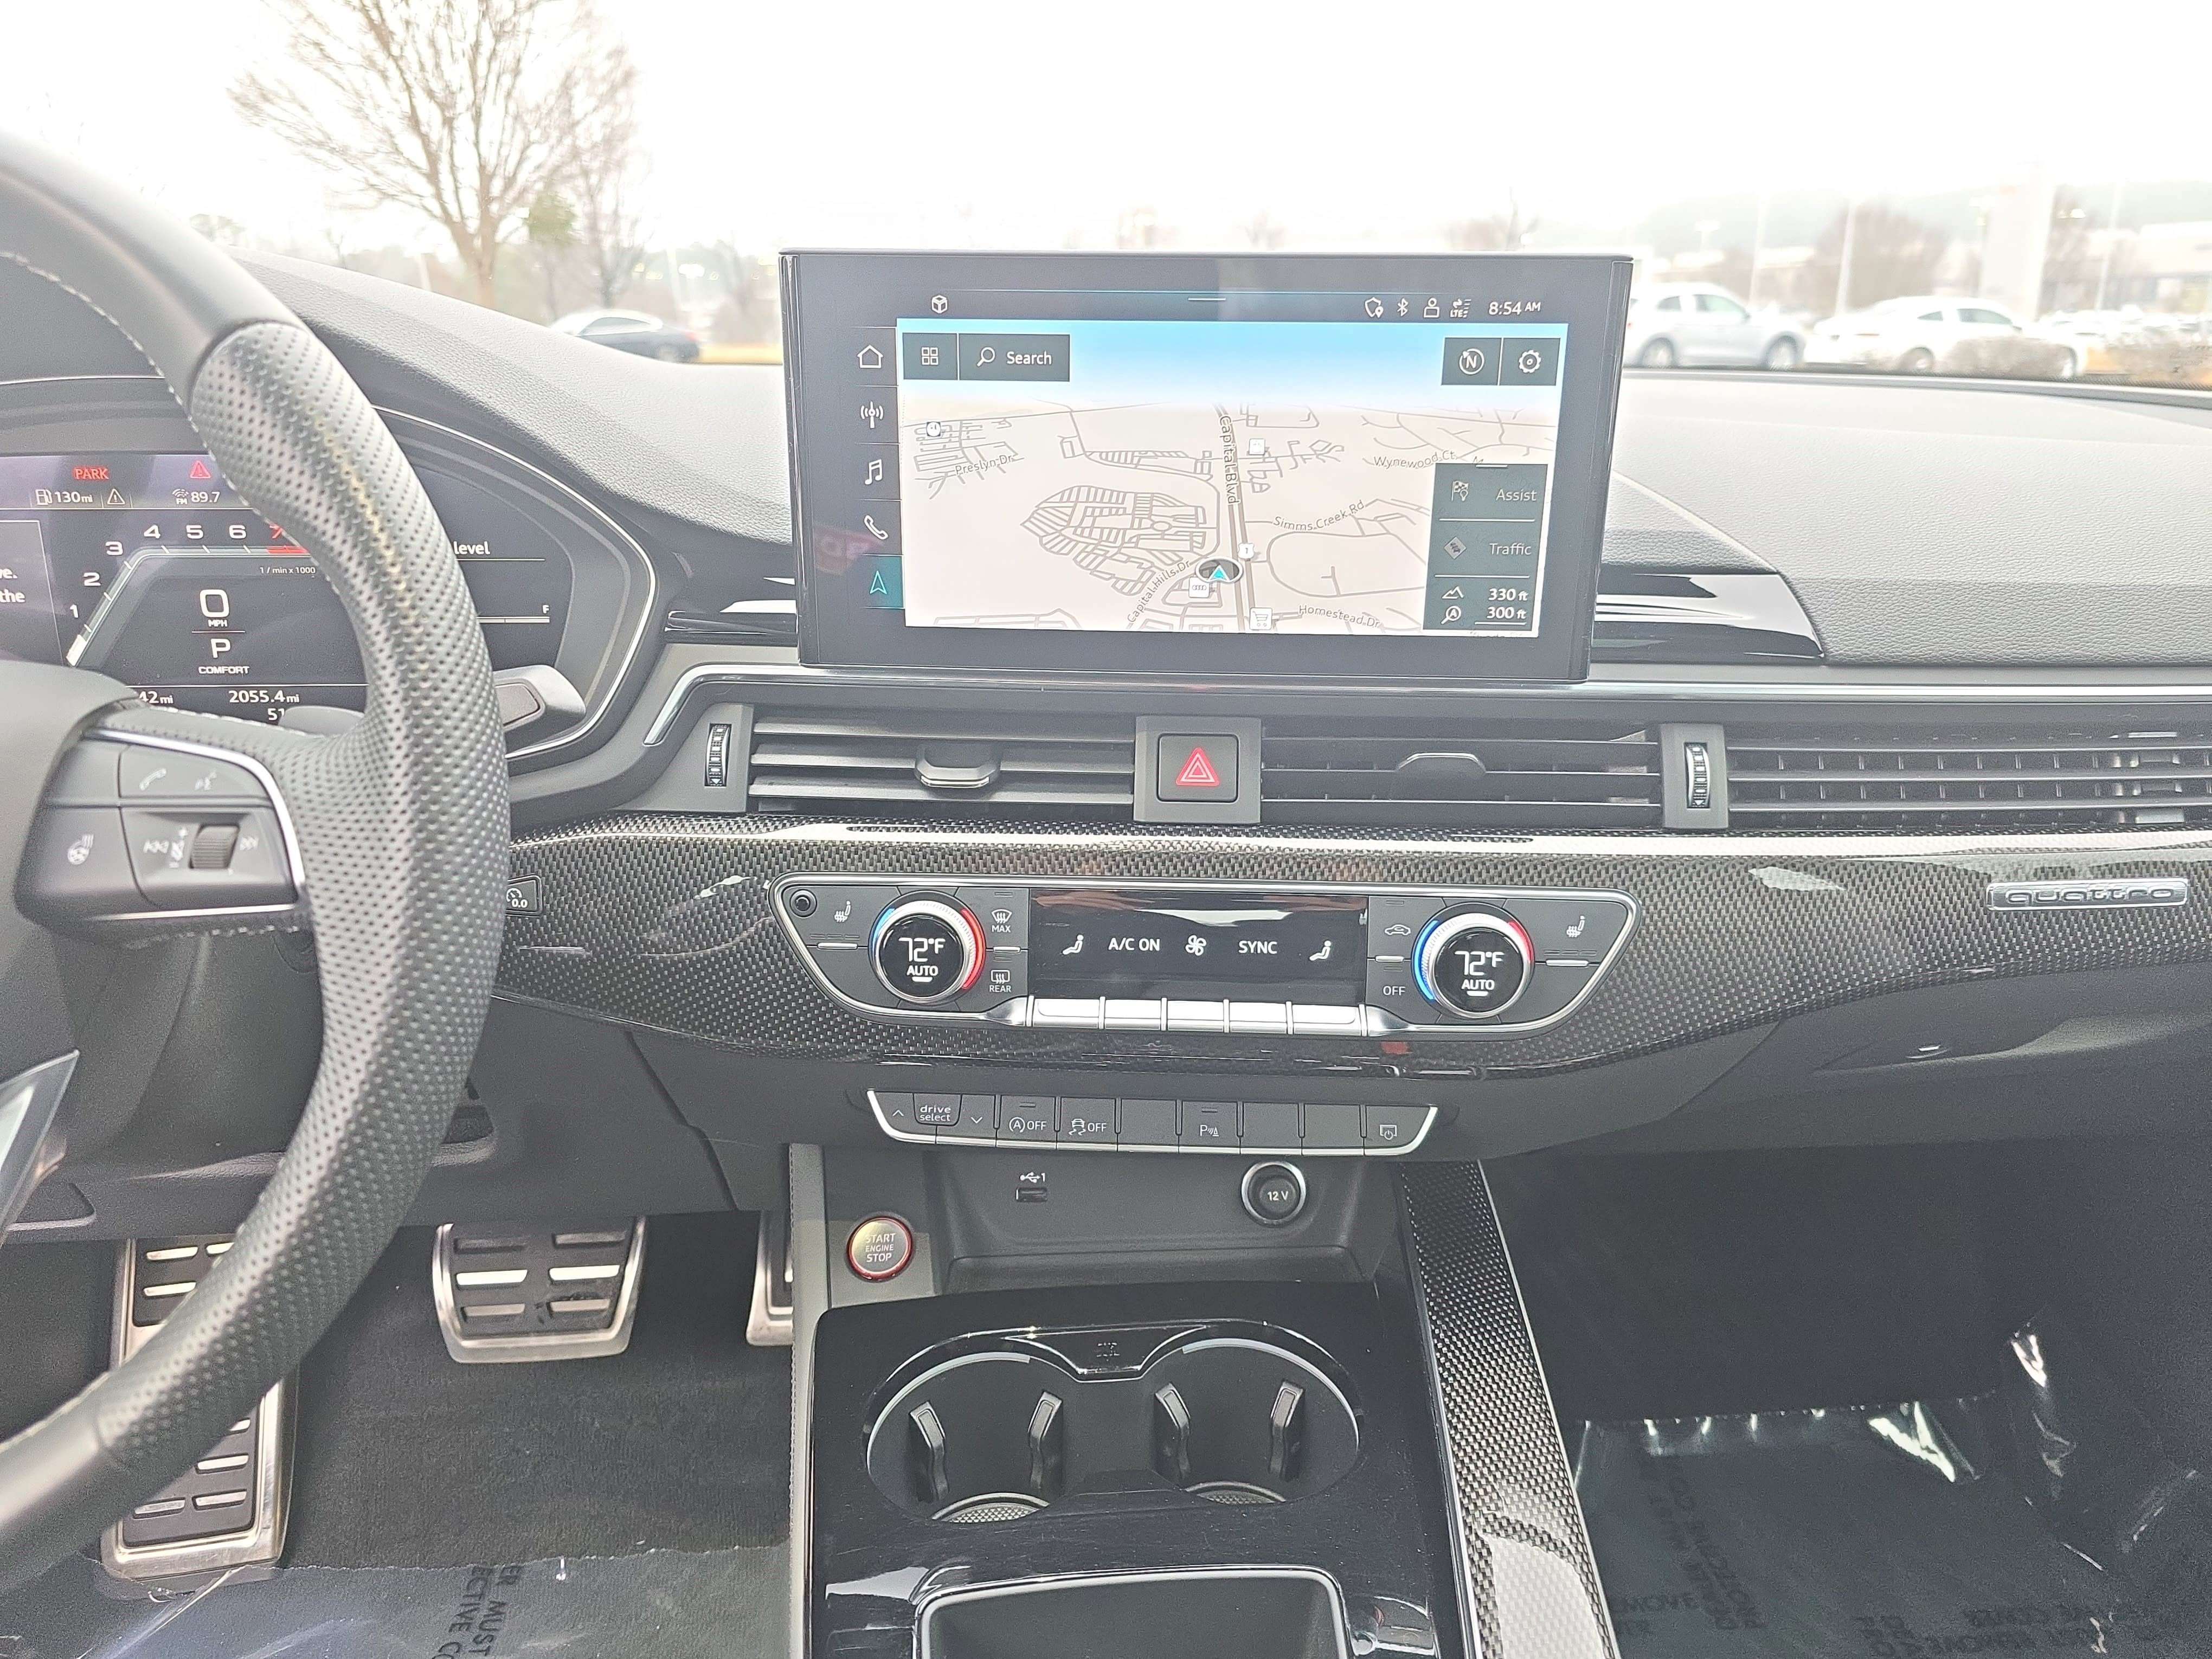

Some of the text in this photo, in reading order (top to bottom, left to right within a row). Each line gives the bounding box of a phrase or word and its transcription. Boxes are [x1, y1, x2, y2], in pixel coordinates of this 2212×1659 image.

[1450, 310, 1463, 318] LTE
[1488, 301, 1541, 316] 8:54 AM
[1007, 351, 1052, 365] Search
[1466, 355, 1477, 369] N
[955, 455, 1012, 474] Preslyn Dr
[1219, 416, 1239, 504] Capital Blvd
[1374, 450, 1455, 469] Wynewood Ct
[75, 468, 109, 480] PARK
[191, 491, 220, 503] 89.7
[1496, 488, 1537, 501] Assist
[1274, 499, 1365, 530] Simms Creek Rd
[144, 525, 161, 539] 4
[186, 525, 203, 539] 5
[229, 525, 246, 539] 6
[105, 542, 123, 555] 3
[453, 541, 491, 555] level
[1489, 543, 1532, 556] Traffic
[83, 573, 101, 586] 2
[1127, 561, 1189, 622] Capital Hills Dr
[1488, 588, 1528, 601] 330 ft
[200, 589, 229, 618] 0
[542, 605, 550, 614] F
[70, 605, 79, 618] 1
[1299, 605, 1380, 628] Homestead Dr
[1487, 607, 1527, 619] 300 ft
[208, 620, 228, 628] MPH
[210, 638, 232, 658] P
[198, 666, 249, 674] COMFORT
[2007, 885, 2175, 907] quattro
[992, 924, 1011, 933] MAX
[899, 938, 946, 962] 72°F
[1108, 938, 1160, 952] A/C ON
[1238, 941, 1277, 955] SYNC
[1455, 951, 1504, 976] 72°F
[906, 966, 938, 976] AUTO
[989, 985, 1012, 993] REAR
[1383, 986, 1406, 995] OFF
[1462, 980, 1495, 991] AUTO
[920, 1105, 951, 1113] drive
[1027, 1121, 1047, 1130] OFF
[1088, 1123, 1107, 1131] OFF
[1267, 1191, 1288, 1201] 12 V
[866, 1233, 896, 1243] START
[865, 1244, 894, 1252] ENGINE
[866, 1253, 892, 1263] STOP
[468, 1600, 507, 1656] MUST
